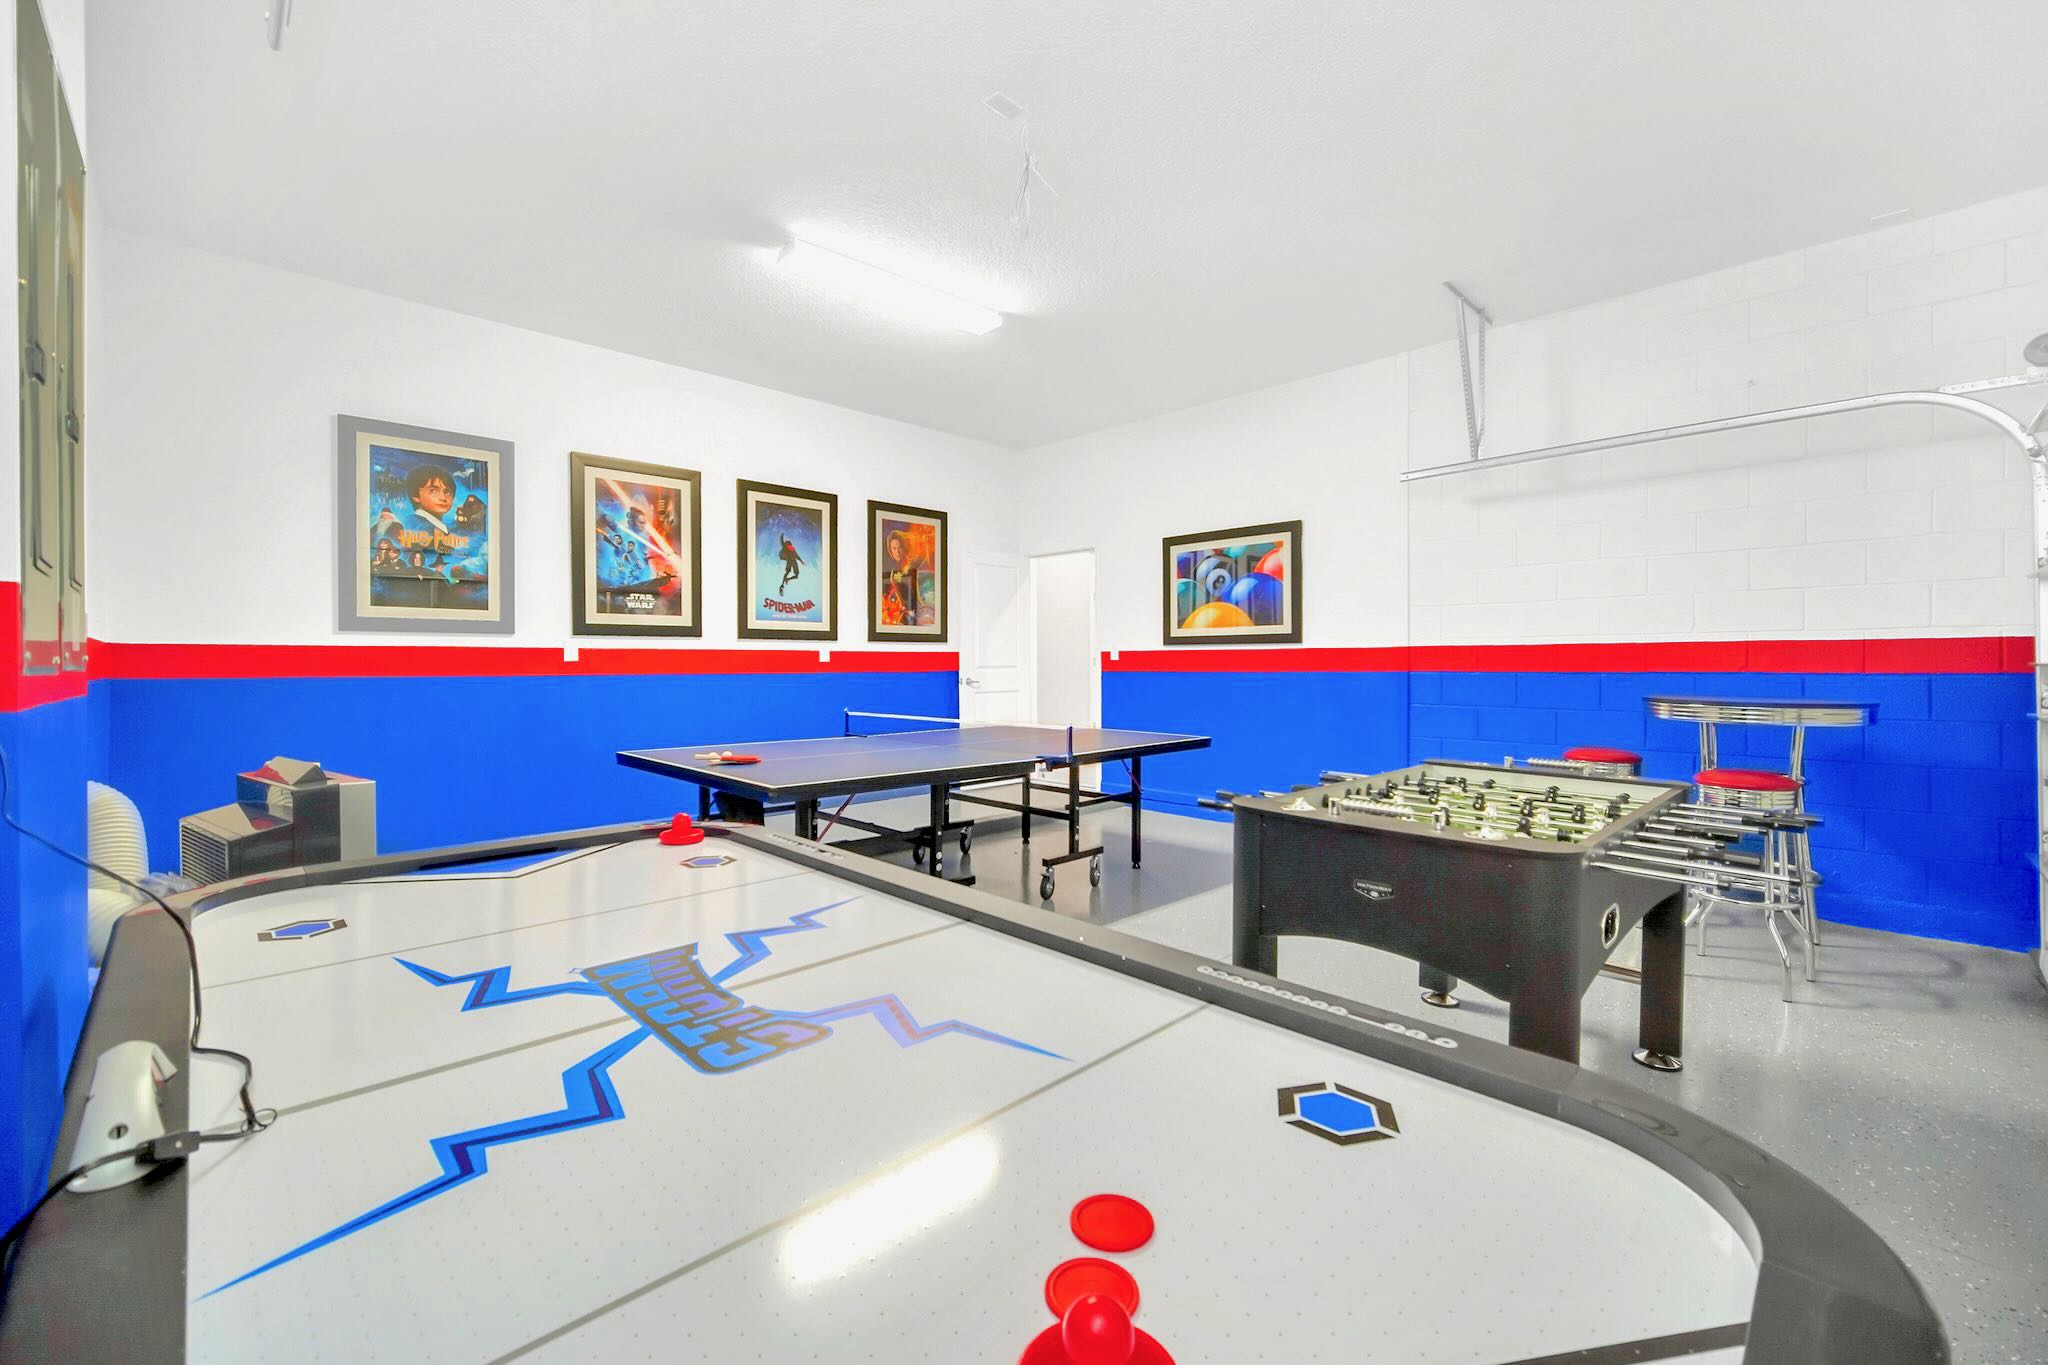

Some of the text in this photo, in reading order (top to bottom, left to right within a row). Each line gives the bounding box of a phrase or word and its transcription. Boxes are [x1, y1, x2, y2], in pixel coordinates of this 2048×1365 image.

[626, 593, 656, 601] STAR
[626, 601, 656, 609] WARS
[763, 597, 815, 614] SPIDER-MAN
[590, 946, 824, 1070] STORM
